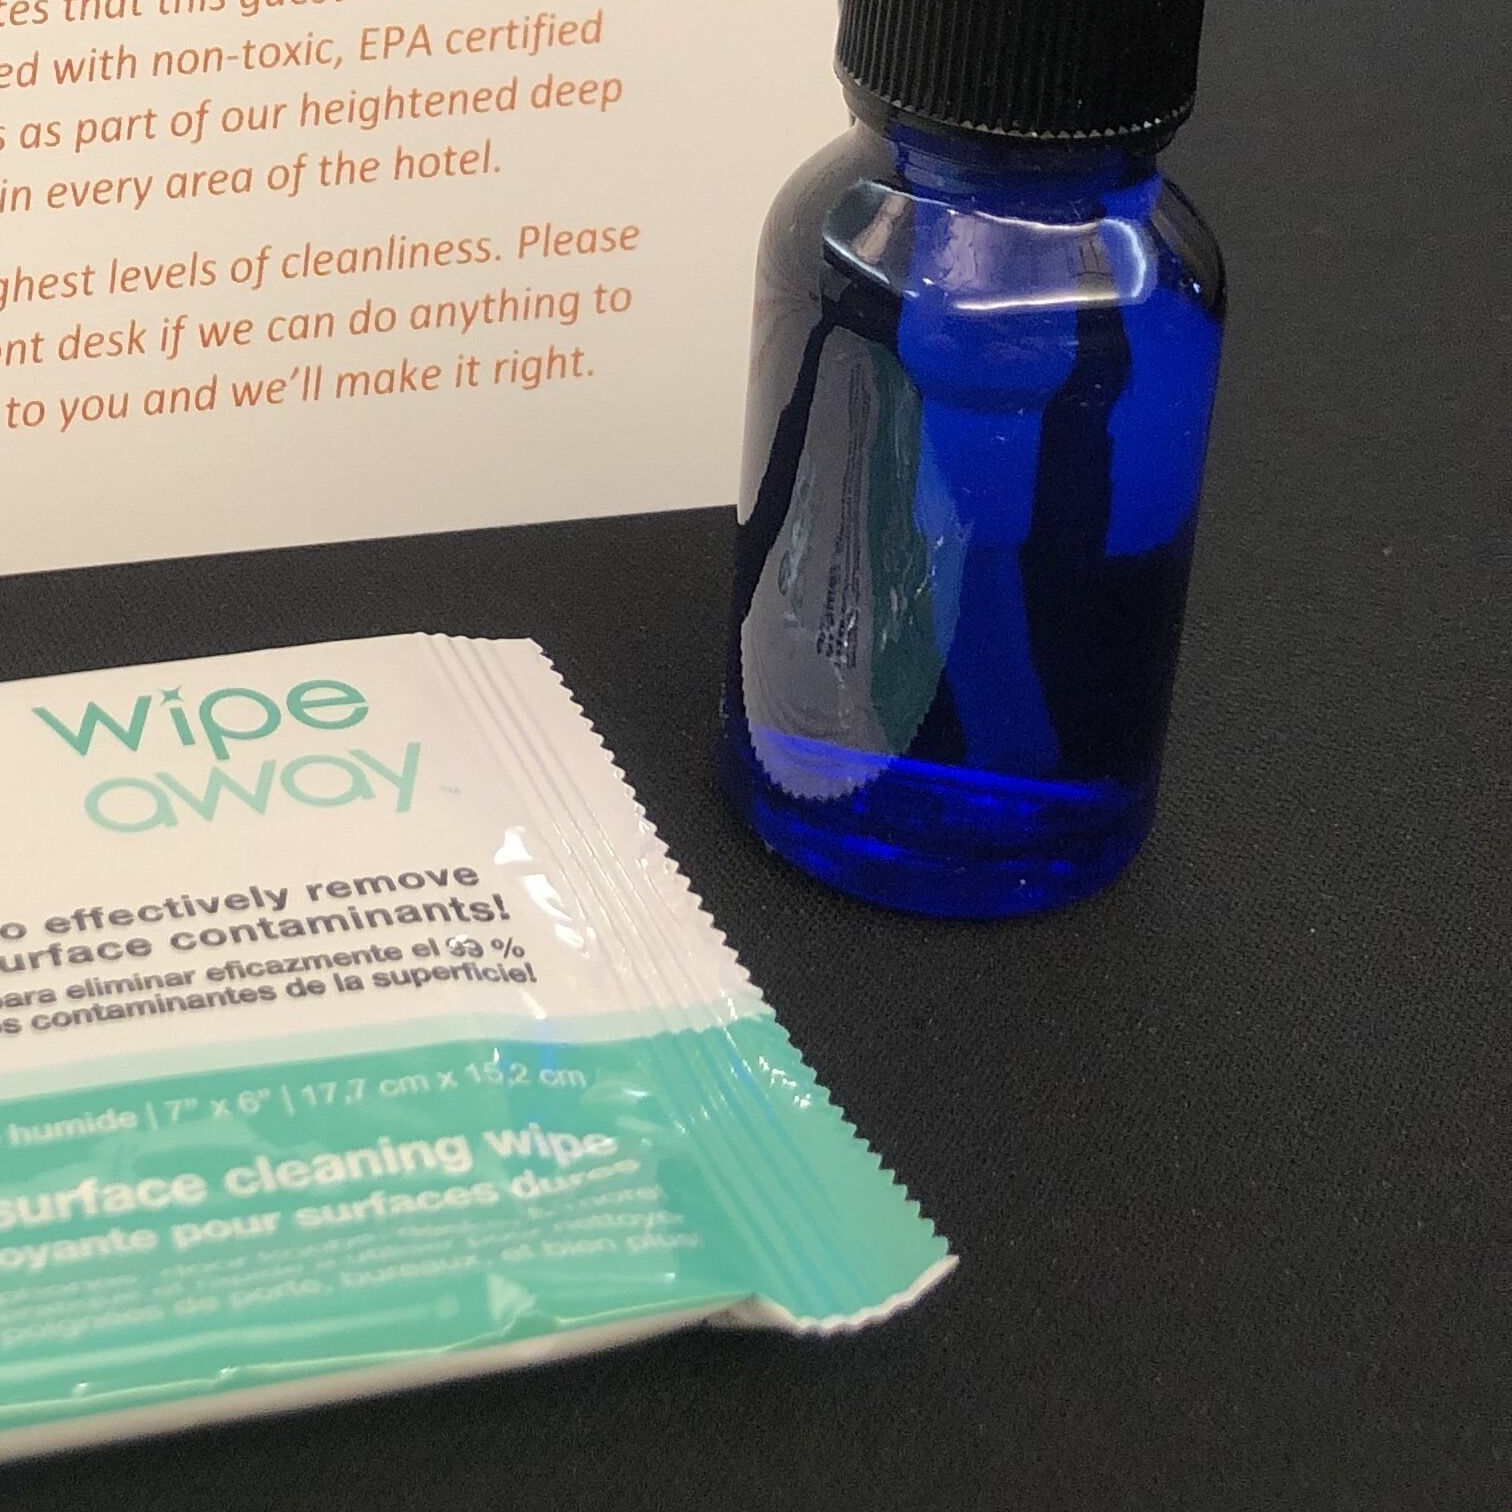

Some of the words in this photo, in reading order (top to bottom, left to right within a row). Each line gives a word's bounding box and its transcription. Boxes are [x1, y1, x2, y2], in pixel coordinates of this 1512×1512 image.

[19, 120, 62, 150] as
[74, 107, 158, 154] part
[170, 98, 212, 145] of
[221, 103, 288, 133] our
[299, 75, 519, 131] heightened
[530, 72, 623, 113] deep
[46, 175, 154, 211] every
[165, 167, 253, 200] area
[266, 151, 309, 198] of
[318, 149, 381, 187] the
[393, 138, 501, 181] hotel.
[109, 250, 217, 295] levels
[230, 244, 273, 291] of
[281, 233, 502, 280] cleanliness.
[517, 222, 641, 260] Please
[32, 679, 369, 761] wipe
[84, 742, 422, 833] away
[44, 885, 289, 934] effectively
[305, 865, 480, 903] remove
[169, 893, 512, 951] contaminants!
[30, 984, 278, 1031] contaminantes
[285, 976, 327, 999] de
[333, 971, 365, 993] la
[371, 961, 538, 989] superficie!
[65, 967, 196, 1000] eliminar
[205, 943, 404, 983] eficazmente
[411, 937, 441, 958] el
[377, 1074, 431, 1099] cm
[222, 1133, 475, 1197] cleaning
[481, 1121, 619, 1167] wipe
[170, 1209, 282, 1251] pour
[293, 1180, 500, 1230] surfaces
